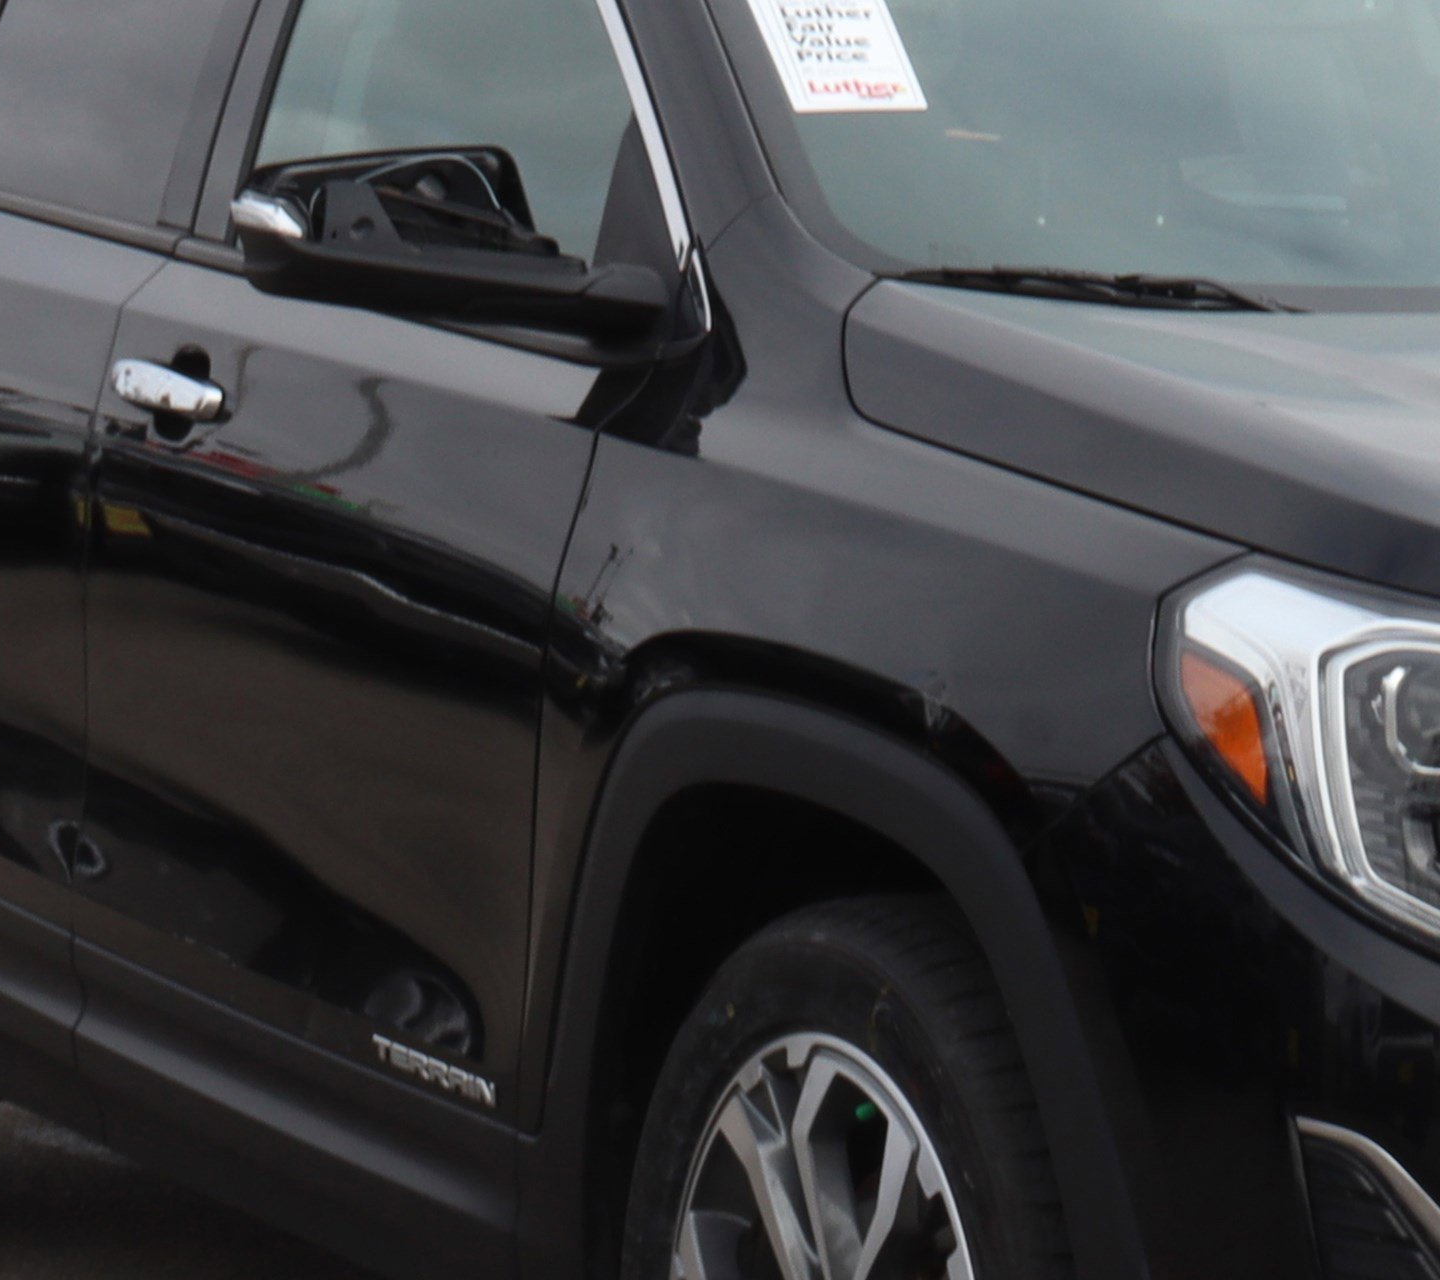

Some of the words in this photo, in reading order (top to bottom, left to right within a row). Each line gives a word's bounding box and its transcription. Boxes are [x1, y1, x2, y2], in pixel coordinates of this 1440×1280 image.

[781, 4, 872, 20] Luther
[790, 34, 869, 47] Value
[797, 49, 868, 62] Price
[371, 1032, 496, 1107] TERRAIN
